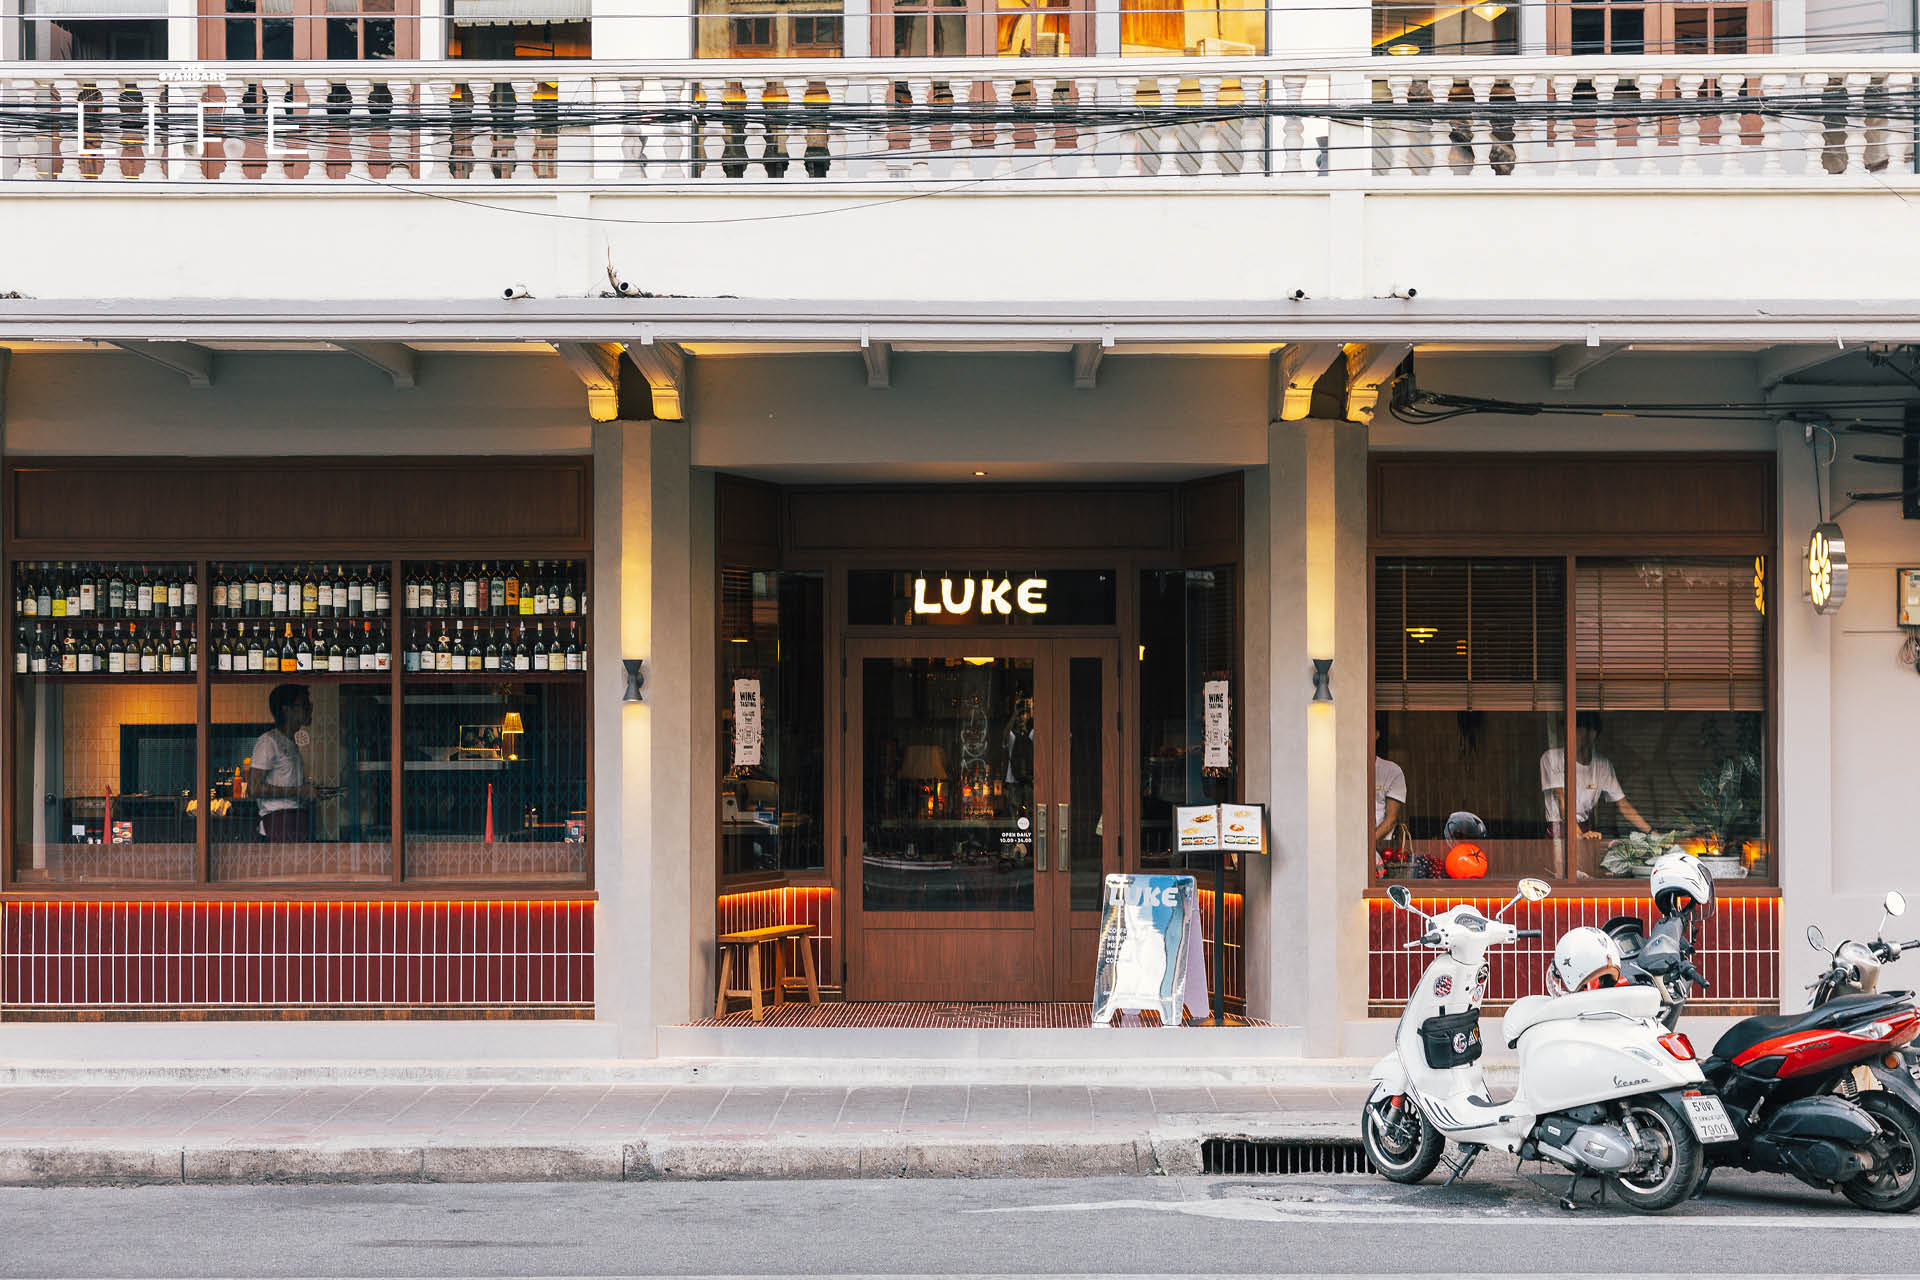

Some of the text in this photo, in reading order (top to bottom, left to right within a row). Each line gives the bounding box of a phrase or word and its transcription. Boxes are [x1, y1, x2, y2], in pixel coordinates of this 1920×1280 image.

[158, 72, 227, 81] STANDARD
[914, 578, 1047, 614] LUKE
[740, 691, 756, 701] WINE
[1209, 693, 1223, 702] WINE
[1109, 886, 1179, 907] LUKE
[1613, 1075, 1652, 1088] Vespa
[1701, 1123, 1728, 1137] 7909
